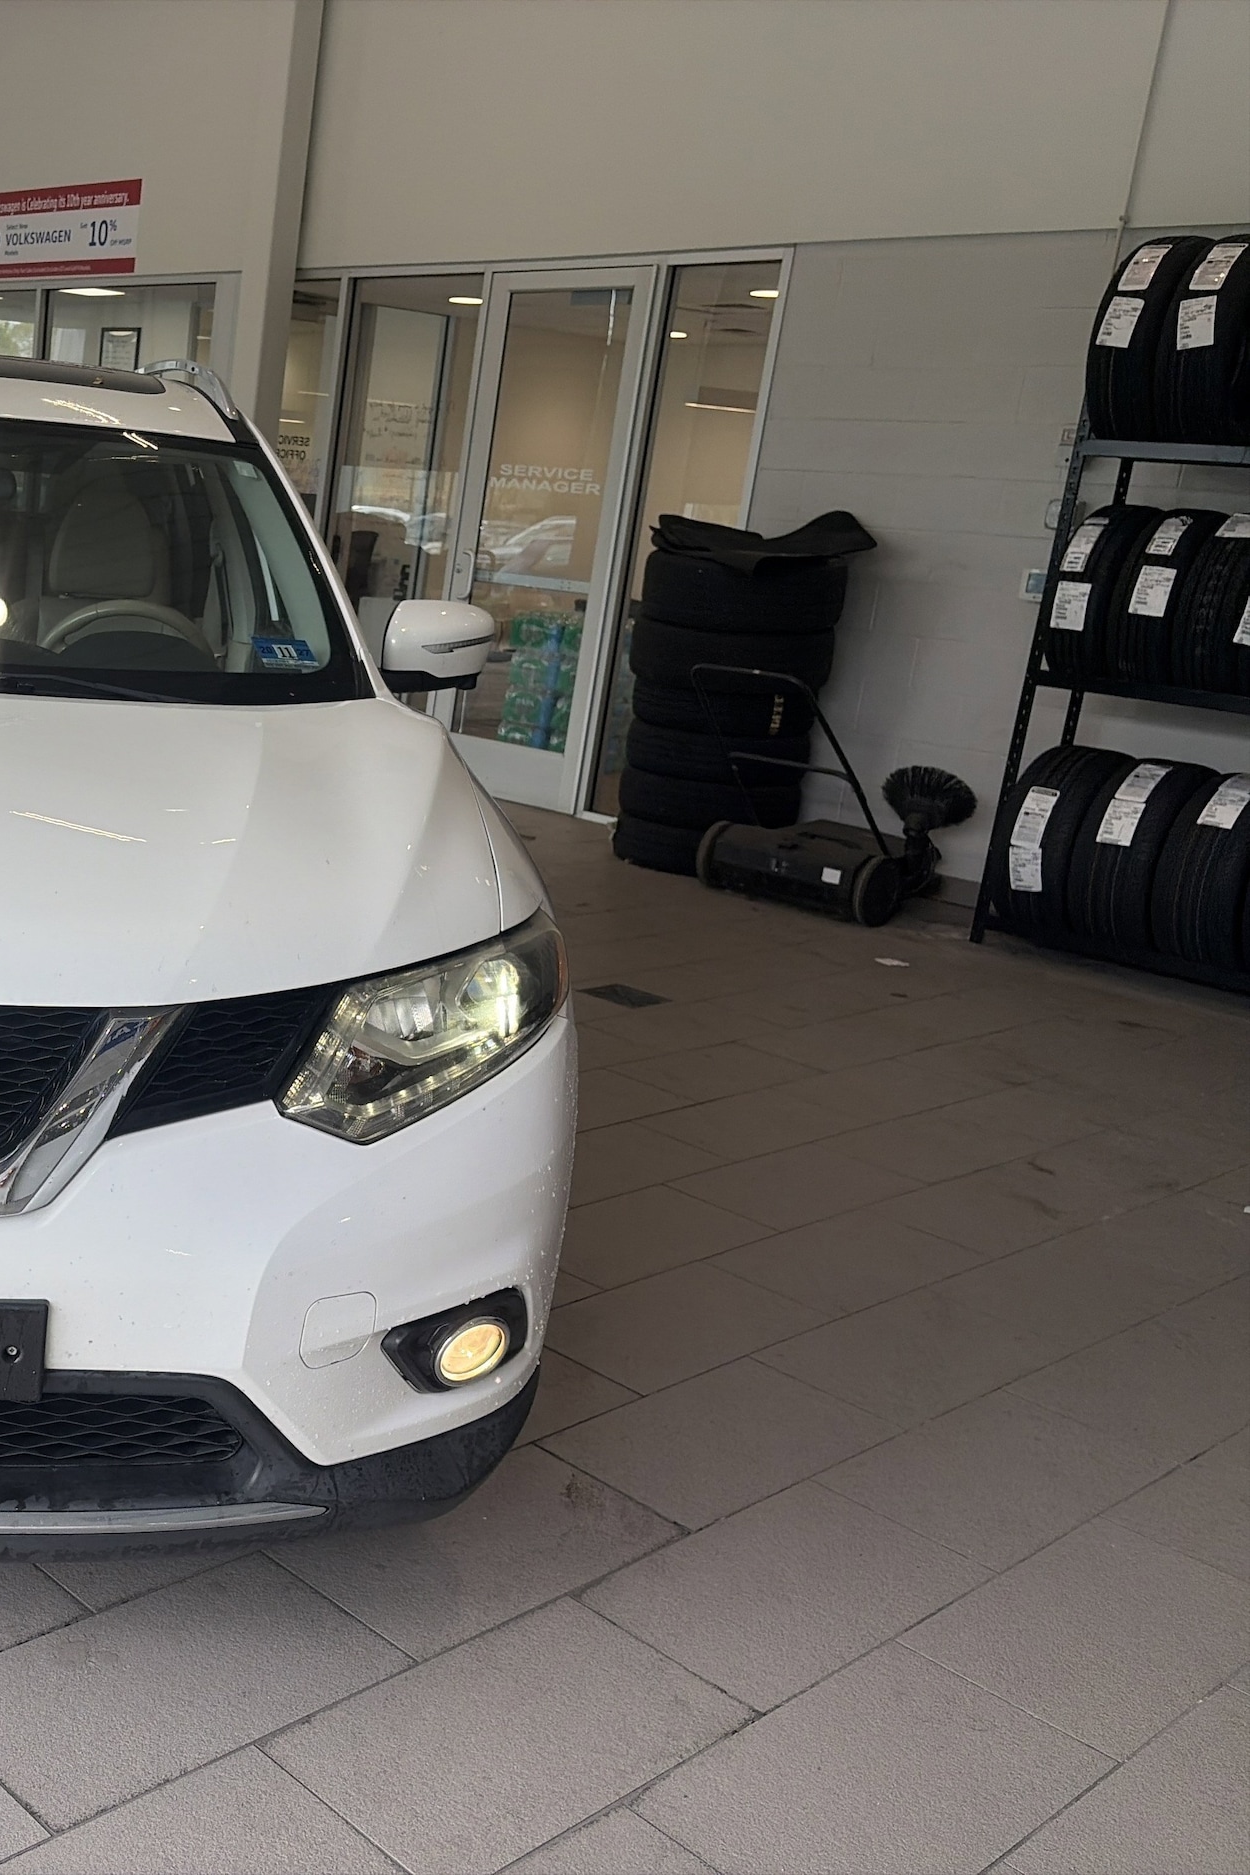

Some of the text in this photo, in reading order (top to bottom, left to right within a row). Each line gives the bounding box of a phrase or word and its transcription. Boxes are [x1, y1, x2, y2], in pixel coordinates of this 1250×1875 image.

[21, 198, 26, 210] is
[27, 197, 57, 212] Celebrating
[80, 194, 94, 210] year
[5, 229, 71, 246] VOLKSWAGEN
[500, 463, 594, 482] SERVICE
[490, 476, 601, 496] MANAGER
[277, 646, 295, 659] 11
